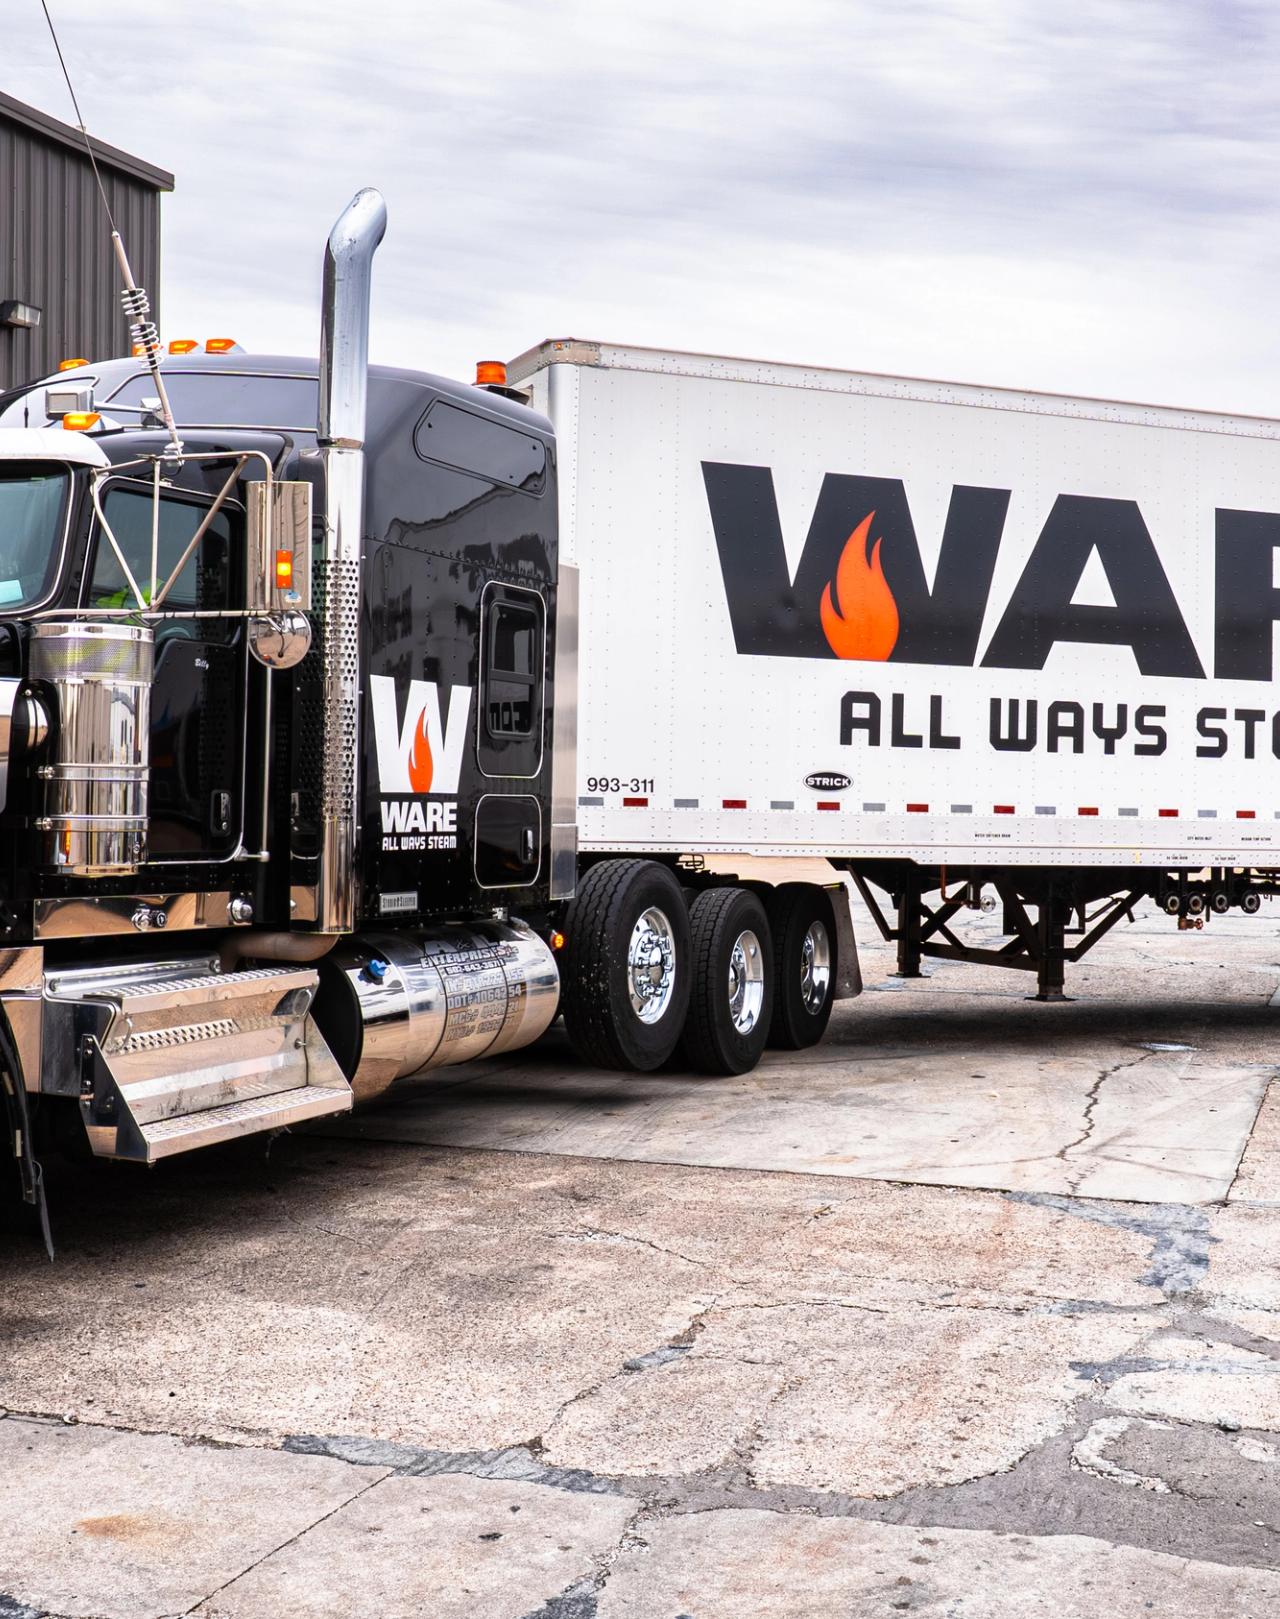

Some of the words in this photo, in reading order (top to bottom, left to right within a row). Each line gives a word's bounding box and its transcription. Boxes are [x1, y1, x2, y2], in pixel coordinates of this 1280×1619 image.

[370, 674, 472, 794] W
[840, 690, 961, 749] ALL
[989, 697, 1167, 757] WAYS
[587, 777, 655, 793] 993-311
[807, 777, 849, 786] STRICK
[380, 801, 458, 833] WARE
[382, 837, 399, 851] ALL
[401, 837, 426, 850] WAYS
[427, 835, 457, 849] STEAM
